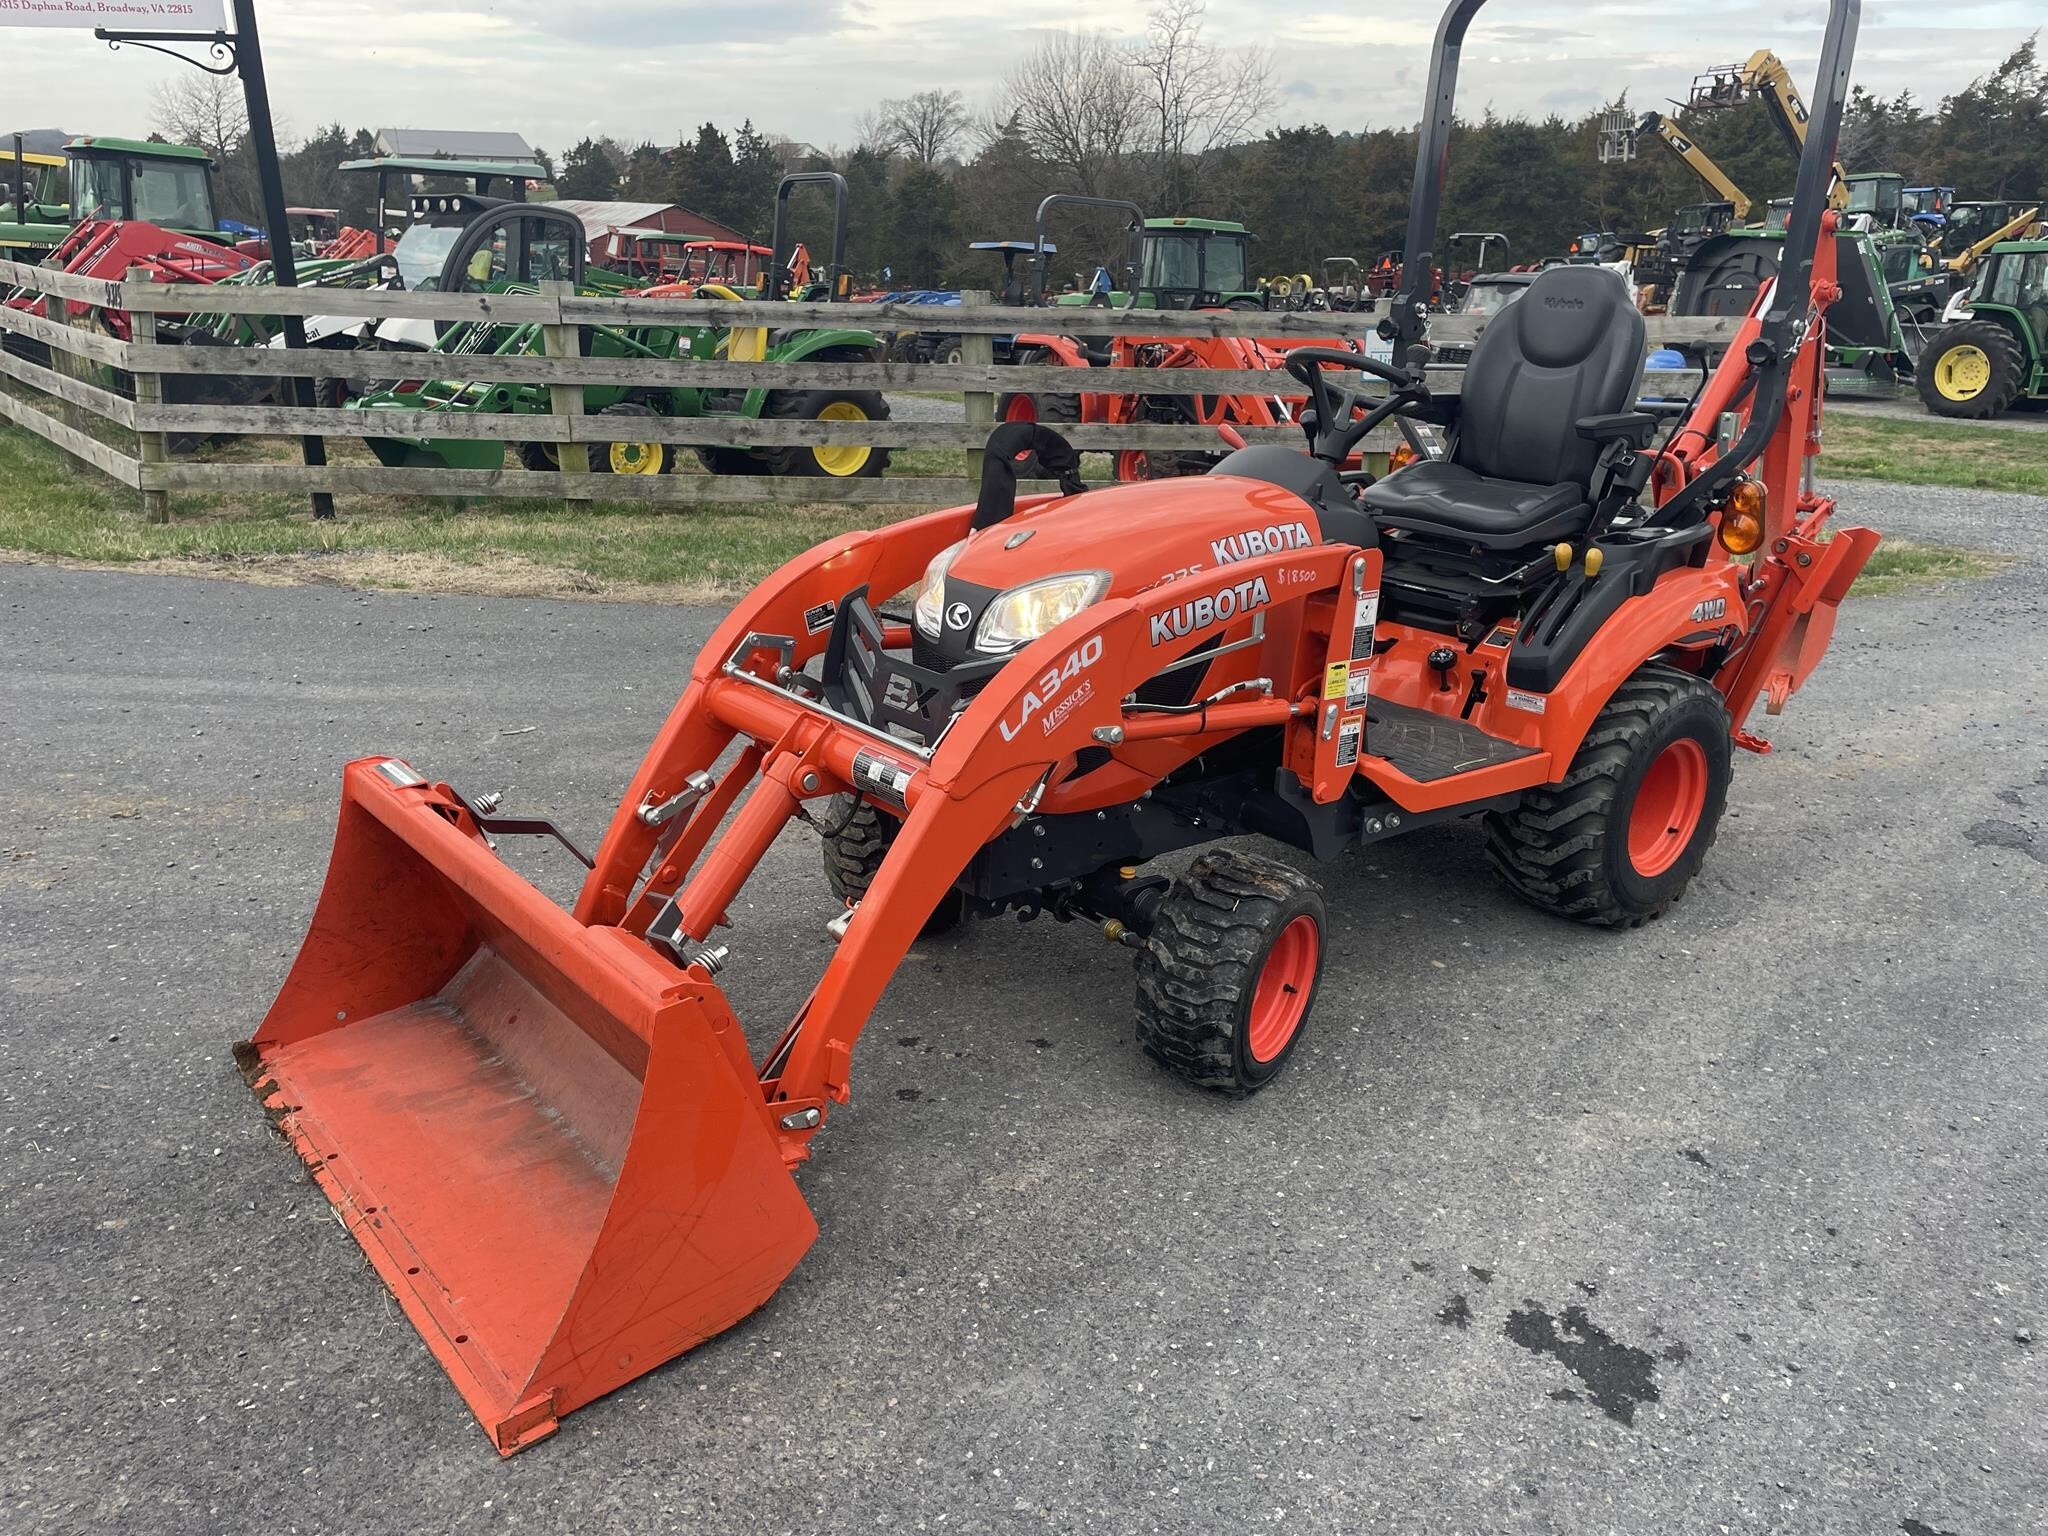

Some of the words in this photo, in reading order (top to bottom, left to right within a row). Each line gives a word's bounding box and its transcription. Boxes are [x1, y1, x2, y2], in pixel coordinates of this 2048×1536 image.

[22, 0, 63, 11] Daphna
[65, 1, 96, 12] Road,
[97, 2, 149, 14] Broadway,
[151, 4, 165, 13] VA
[167, 4, 193, 14] 22815
[1211, 522, 1312, 567] KUBOTA
[1277, 568, 1317, 586] $18500
[1150, 576, 1271, 647] KUBOTA
[1690, 597, 1726, 623] 4WD
[882, 672, 939, 720] BX
[999, 635, 1103, 742] LA340
[1042, 679, 1091, 734] MESSICK'S
